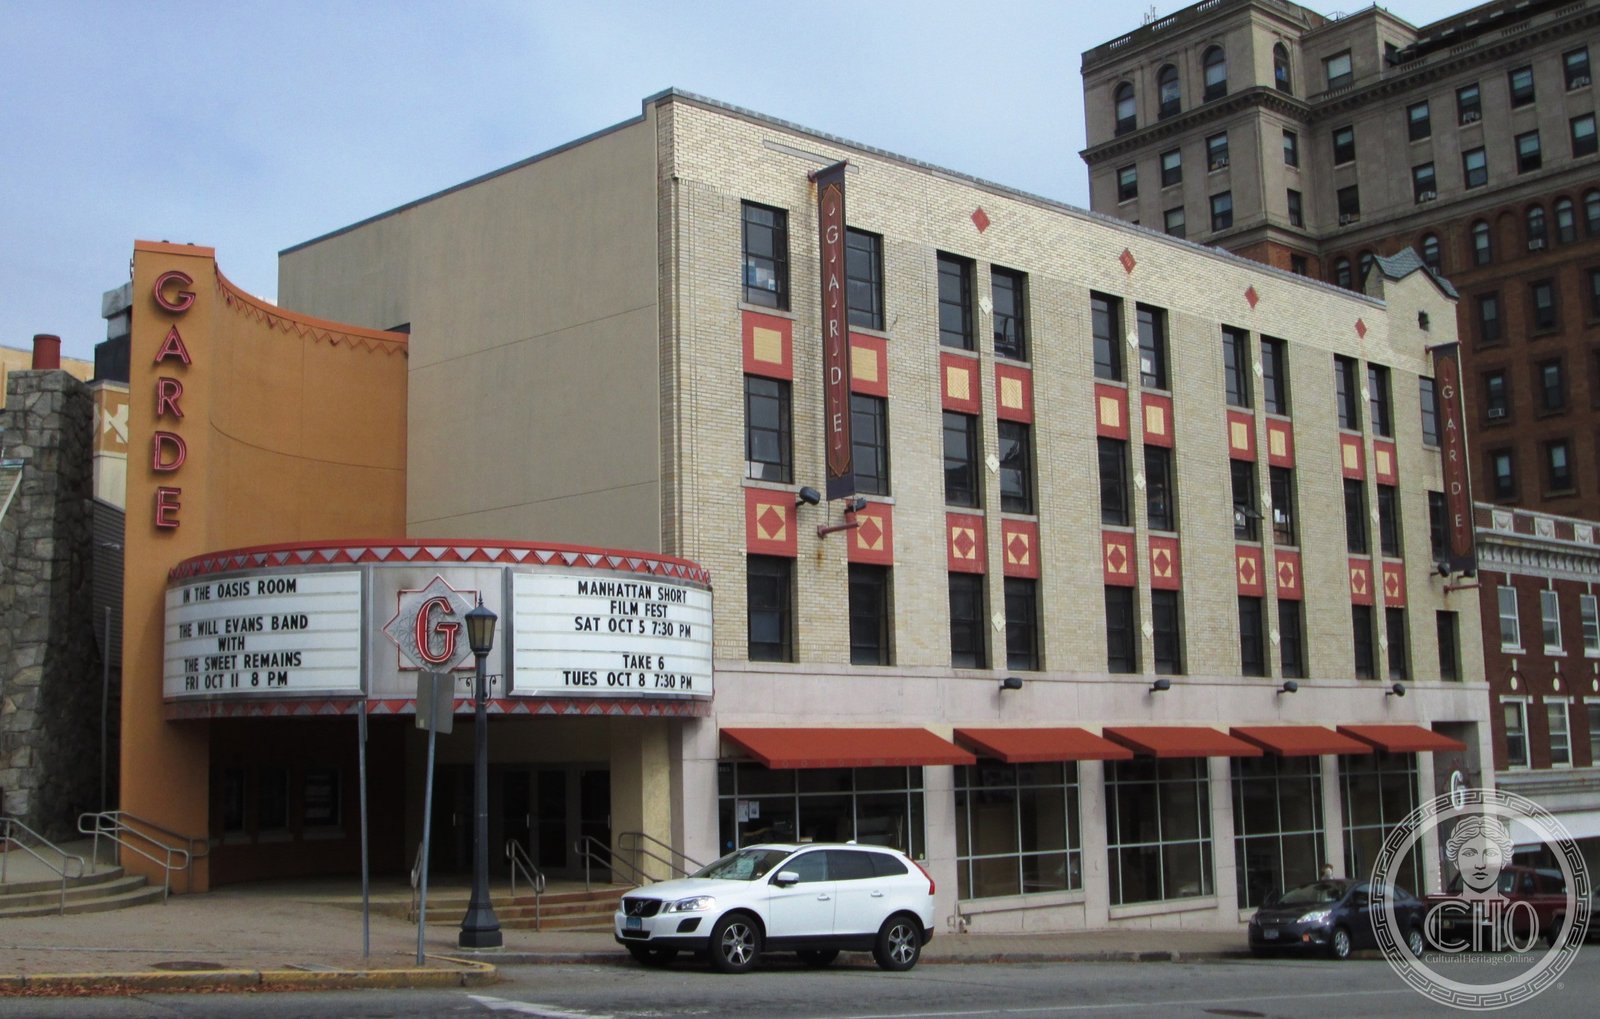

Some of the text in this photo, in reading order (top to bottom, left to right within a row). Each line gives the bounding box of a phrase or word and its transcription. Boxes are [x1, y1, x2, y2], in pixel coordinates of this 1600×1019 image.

[826, 225, 841, 432] GARDE
[153, 270, 196, 528] GARDE
[1442, 386, 1462, 527] GARDE
[183, 578, 297, 602] IN THE OASIS ROOM
[578, 581, 687, 604] MANHATTAN SHORT
[610, 600, 668, 619] FILM FEST
[179, 615, 309, 639] THE WILL EVANS BAND
[416, 597, 460, 663] G
[574, 616, 691, 639] SAT OCT 5 7:30 PM
[218, 636, 245, 652] WITH
[184, 651, 302, 673] THE SWEET REMAINS
[622, 654, 665, 671] TAKE 6
[185, 676, 199, 691] FRI
[204, 673, 224, 689] OCT
[251, 672, 259, 687] 8
[268, 671, 287, 686] PM
[563, 670, 692, 690] TUES OCT 8 7:30 PM
